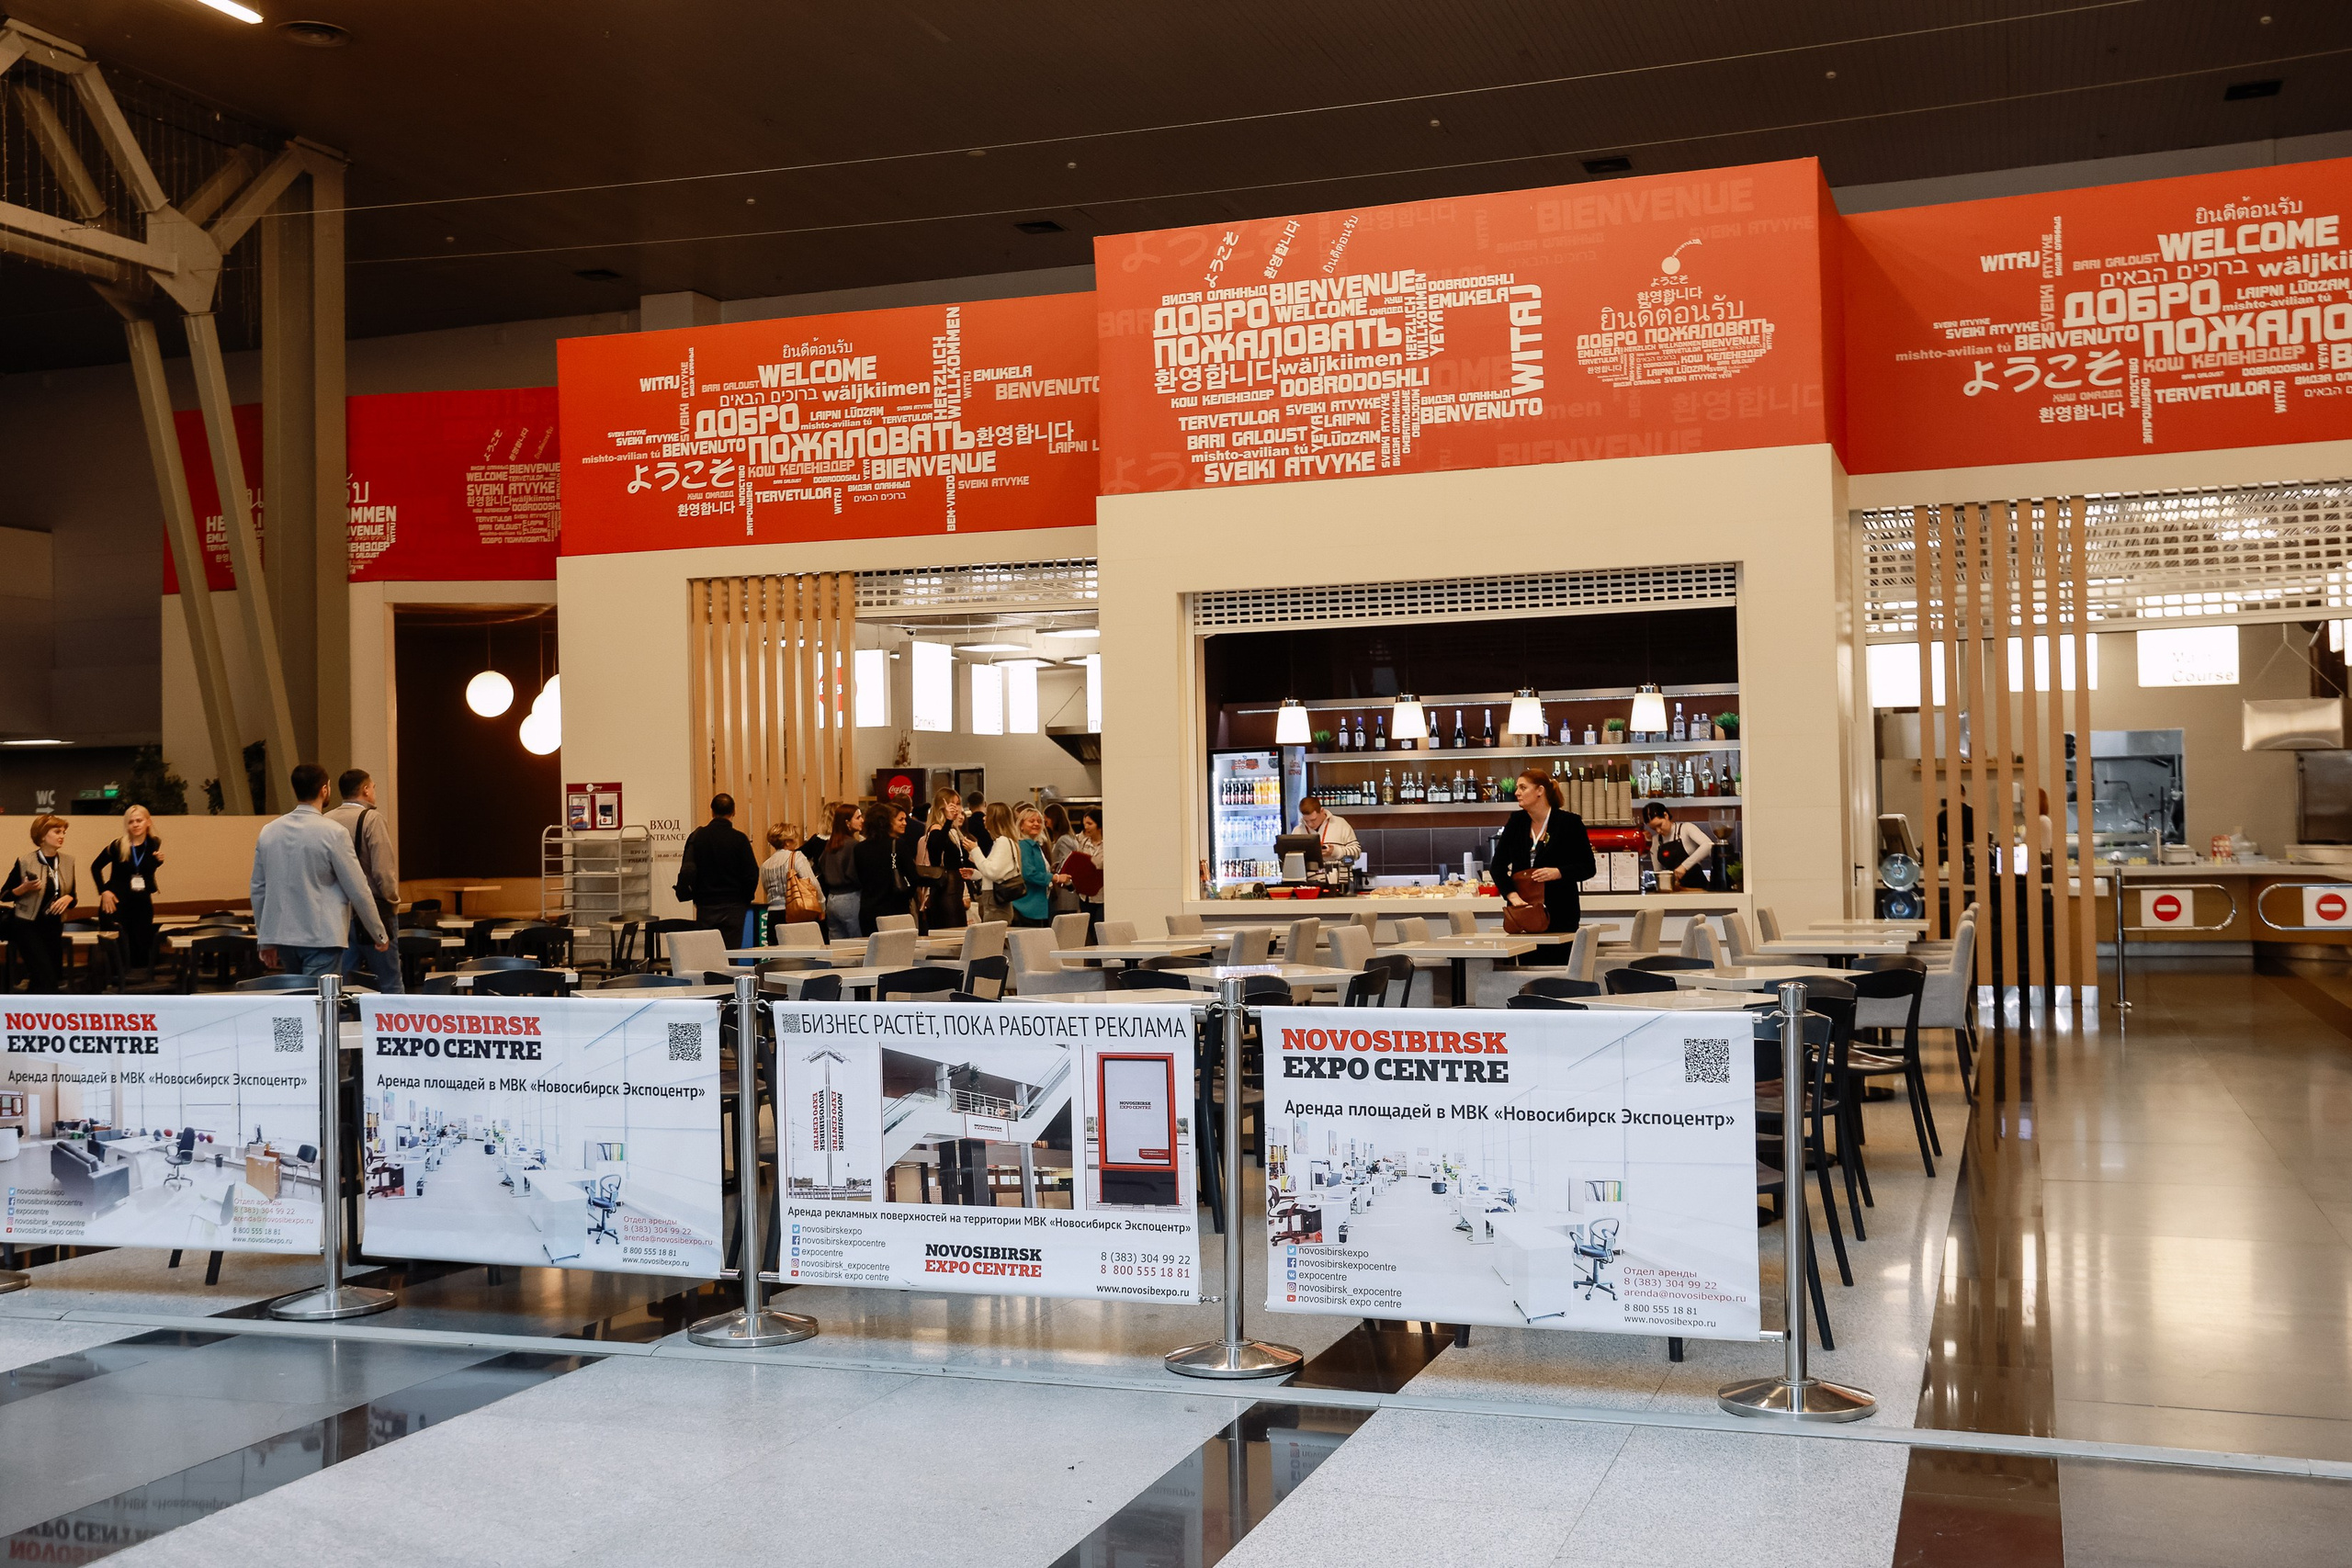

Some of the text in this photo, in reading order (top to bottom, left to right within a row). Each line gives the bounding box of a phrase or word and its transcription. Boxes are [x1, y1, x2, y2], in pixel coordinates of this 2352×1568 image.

[1263, 220, 1301, 279] 환영합니다
[2157, 215, 2340, 263] WELCOME
[1204, 231, 1239, 288] ようこそ
[1980, 250, 2041, 273] WITAJ
[1270, 269, 1416, 307] BIENVENUE
[1428, 273, 1514, 291] DOBRODOSHLI
[1650, 275, 1689, 288] ようこそ
[1274, 298, 1367, 322] WELCOME
[1428, 287, 1510, 310] EMUKELA
[2062, 278, 2221, 328] ДОБРО
[1153, 298, 1270, 338] ДОБРО
[1415, 273, 1429, 360] WILLKOMMEN
[1405, 296, 1418, 361] HERZLICH
[1577, 319, 1775, 350] ДОБРО ПОЖАЛОВАТЬ
[2014, 323, 2140, 352] BENVENUTO
[1153, 317, 1403, 368] ПОЖАЛОВАТЬ
[1509, 284, 1544, 397] WITAJ
[1702, 334, 1759, 349] BIENVENUE
[757, 355, 876, 389] WELCOME
[946, 307, 962, 419] WILLKOMMEN
[1280, 352, 1402, 377] wäljkiimen
[1963, 348, 2124, 396] ようこそ
[639, 375, 680, 392] WITAJ
[1154, 358, 1281, 394] 환영합니다
[1280, 367, 1430, 398] DOBRODOSHLI
[821, 380, 931, 403] wäljkiimen
[1171, 396, 1197, 408] КОШ
[2154, 379, 2271, 403] TERVETULOA
[695, 402, 800, 439] ДОБРО
[1178, 409, 1280, 431] TERVETULOA
[1420, 398, 1543, 424] BENVENUTO
[2039, 400, 2125, 423] 환영합니다
[748, 421, 976, 466] ПОЖАЛОВАТЬ
[976, 421, 1074, 448] 환영합니다
[1187, 426, 1308, 450] BARI GALOUST
[662, 438, 746, 457] BENVENUTO
[1191, 444, 1308, 463] mishto-avilian tú
[466, 471, 508, 481] WELCOME
[627, 457, 735, 494] ようこそ
[871, 450, 997, 480] BIENVENUE
[1204, 450, 1376, 483] SVEIKI ATVYKE
[467, 481, 555, 496] SVEIKI ATVYKE
[755, 486, 832, 503] TERVETULOA
[36, 790, 55, 806] WC
[650, 819, 680, 831] ВХОД
[5, 1012, 158, 1032] NOVOSIBIRSK
[375, 1012, 542, 1036] NOVOSIBIRSK
[801, 1012, 1187, 1039] БИЗНЕС РАСТЁТ, ПОКА РАБОТАЕТ РЕКЛАМА
[6, 1035, 159, 1055] EXPO CENTRE
[376, 1037, 542, 1061] EXPO CENTRE
[1281, 1028, 1509, 1055] NOVOSIBIRSK
[8, 1069, 308, 1089] Аренда площадей в МВК «Новосибирск Экспоцентр»
[1283, 1055, 1510, 1084] EXPO CENTRE
[377, 1074, 706, 1100] Аренда площадей в МВК «Новосибирск Экспоцентр»
[1284, 1100, 1736, 1130] Аренда площадей в МВК «Новосибирск Экспоцентр»
[649, 1217, 677, 1225] аренды
[787, 1206, 822, 1218] Аренда
[824, 1209, 877, 1220] рекламных
[880, 1212, 947, 1224] поверхностей
[964, 1215, 1022, 1226] территории
[1024, 1216, 1046, 1226] МВК
[1049, 1217, 1122, 1231] «Новосибирск
[1125, 1220, 1191, 1235] Экспоцентр»
[801, 1225, 863, 1235] novosibirskexpo
[624, 1235, 713, 1246] arenda@novosibexpo.ru
[801, 1236, 886, 1247] novosibirskexpocentre
[622, 1257, 689, 1267] www.novosibexpo.ru
[801, 1248, 843, 1258] expocentre
[925, 1244, 1042, 1261] NOVOSIBIRSK
[1101, 1252, 1190, 1265] 8 (383) 304 99 22
[1298, 1247, 1369, 1258] novosibirskexpo
[800, 1270, 889, 1281] novosibirsk expo centre
[801, 1259, 890, 1271] novosibirsk_expocentre
[925, 1259, 1042, 1278] EXPO CENTRE
[1101, 1265, 1190, 1279] 8 800 555 18 81
[1298, 1259, 1396, 1271] novosibirskexpocentre
[1298, 1272, 1347, 1280] expocentre
[1623, 1267, 1697, 1279] Отдел аренды
[1097, 1285, 1190, 1297] www.novosibexpo.ru
[1298, 1284, 1402, 1297] novosibirsk_expocentre
[1634, 1278, 1662, 1288] (383)
[1666, 1280, 1684, 1288] 304
[1688, 1280, 1701, 1289] 99
[1298, 1295, 1402, 1308] novosibirsk expo centre
[1624, 1290, 1747, 1303] arenda@novosibexpo.ru
[1634, 1304, 1649, 1313] 800
[1654, 1305, 1669, 1314] 555
[1687, 1307, 1698, 1315] 81
[1624, 1315, 1716, 1328] www.novosibexpo.ru
